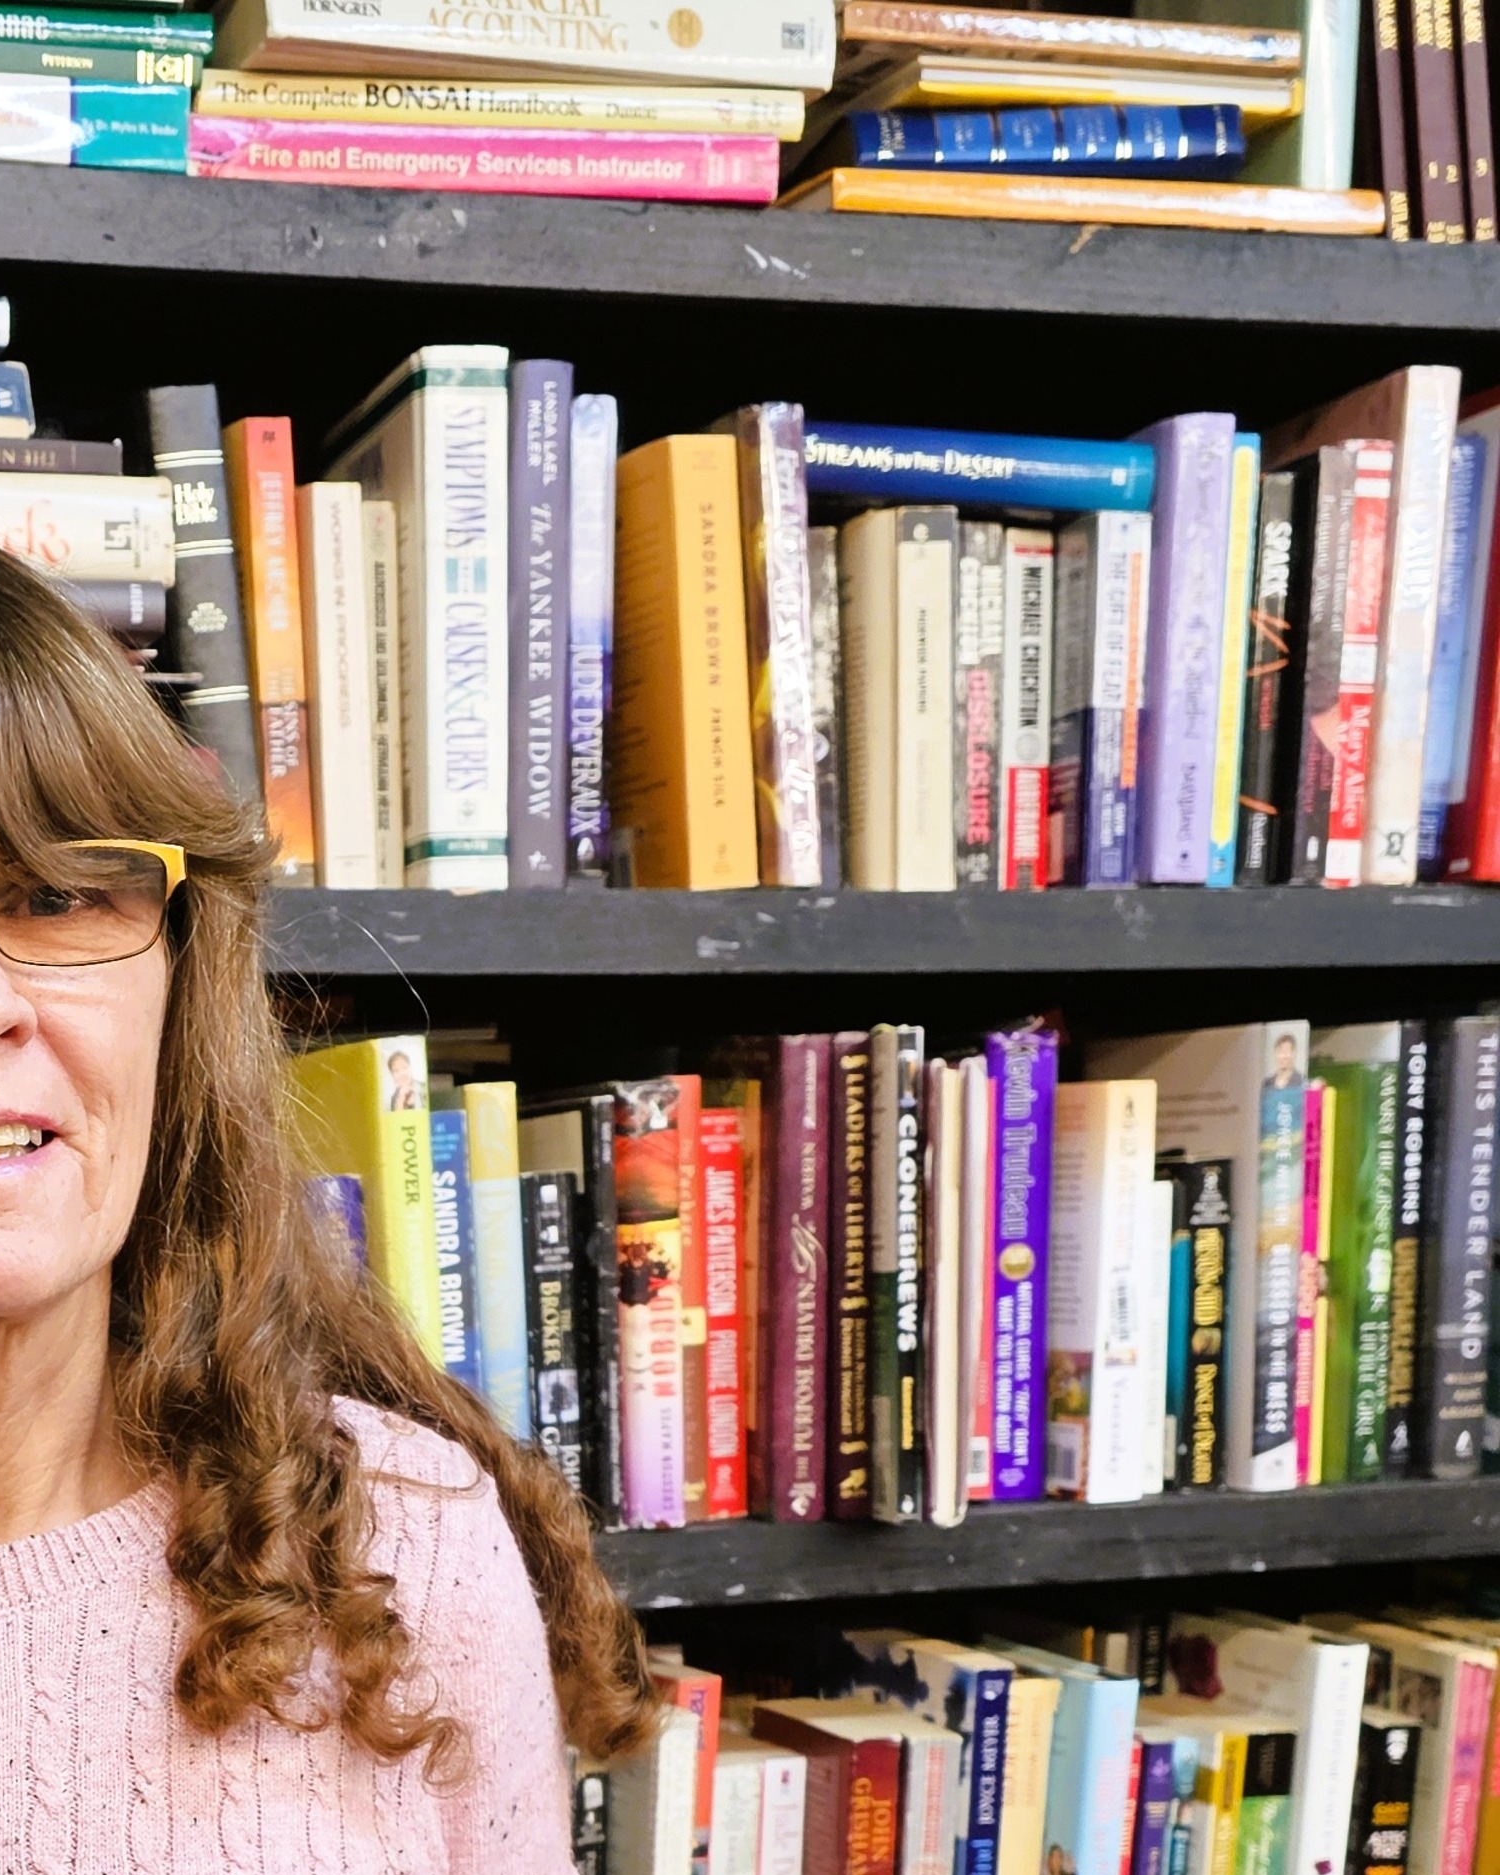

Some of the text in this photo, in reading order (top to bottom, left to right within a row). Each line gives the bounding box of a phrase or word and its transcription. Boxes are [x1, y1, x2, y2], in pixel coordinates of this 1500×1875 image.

[425, 7, 629, 54] ACCOUNTING
[217, 81, 582, 116] The Complete BONSAI Handbook
[249, 144, 685, 179] Fire and Emergency Services Instructor
[23, 446, 59, 466] THE
[443, 405, 488, 551] SYMPTOMS
[526, 399, 542, 467] MILLER
[804, 435, 894, 470] STREAMS
[945, 448, 1017, 480] DESERT
[1261, 520, 1292, 598] SPARK
[527, 503, 553, 820] The YANKEE WIDOW
[268, 707, 286, 777] FATHER
[282, 702, 298, 767] SINS OF
[569, 643, 604, 838] JUDE DEVERAUX
[965, 669, 991, 844] DISCLOSURE
[1344, 704, 1370, 827] Mary Alice
[400, 1125, 420, 1206] POWER
[845, 1072, 863, 1172] LEADERS
[1001, 1040, 1038, 1240] Kevin Trudeau
[1402, 1042, 1426, 1225] TONY ROBBINS
[705, 1166, 738, 1317] JAMES PATTERSON
[897, 1113, 918, 1352] CLONEBREWS
[1460, 1033, 1499, 1360] THIS TENDER LAND
[432, 1171, 466, 1363] SANDRA BROWN
[844, 1202, 863, 1292] LIBERTY
[539, 1280, 562, 1365] BROKER
[707, 1329, 739, 1459] PRIVATE LONDON
[1266, 1381, 1288, 1433] MESS
[872, 1799, 892, 1860] JOHN
